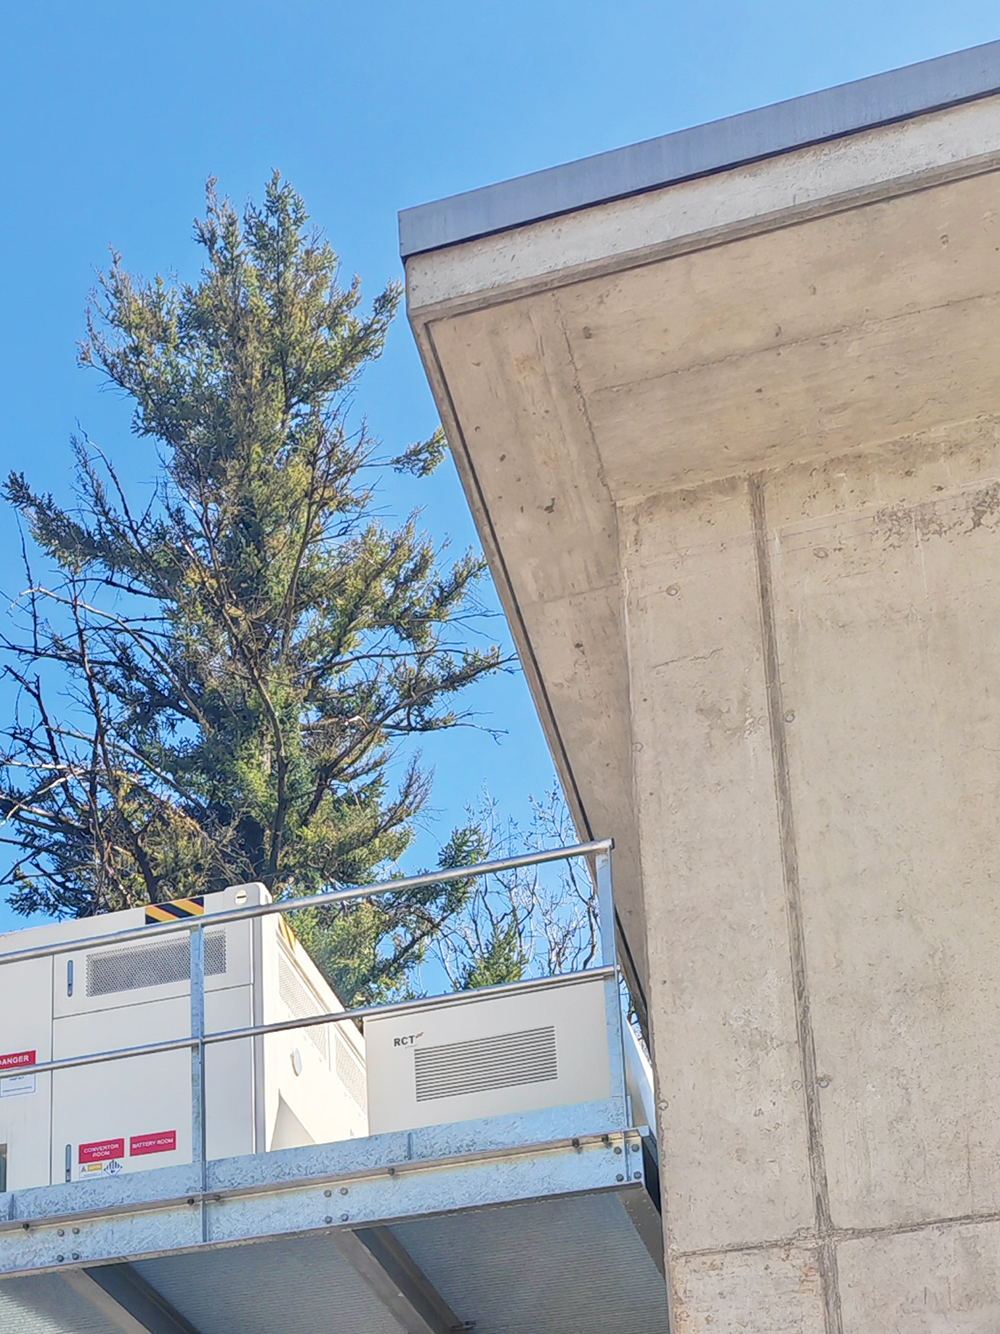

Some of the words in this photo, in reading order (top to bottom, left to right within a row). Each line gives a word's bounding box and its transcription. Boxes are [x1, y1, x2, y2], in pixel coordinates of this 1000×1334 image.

[394, 1035, 415, 1047] RCT
[83, 1143, 119, 1154] CONVERTOR
[132, 1141, 157, 1149] BATTERY
[156, 1138, 174, 1146] ROOM
